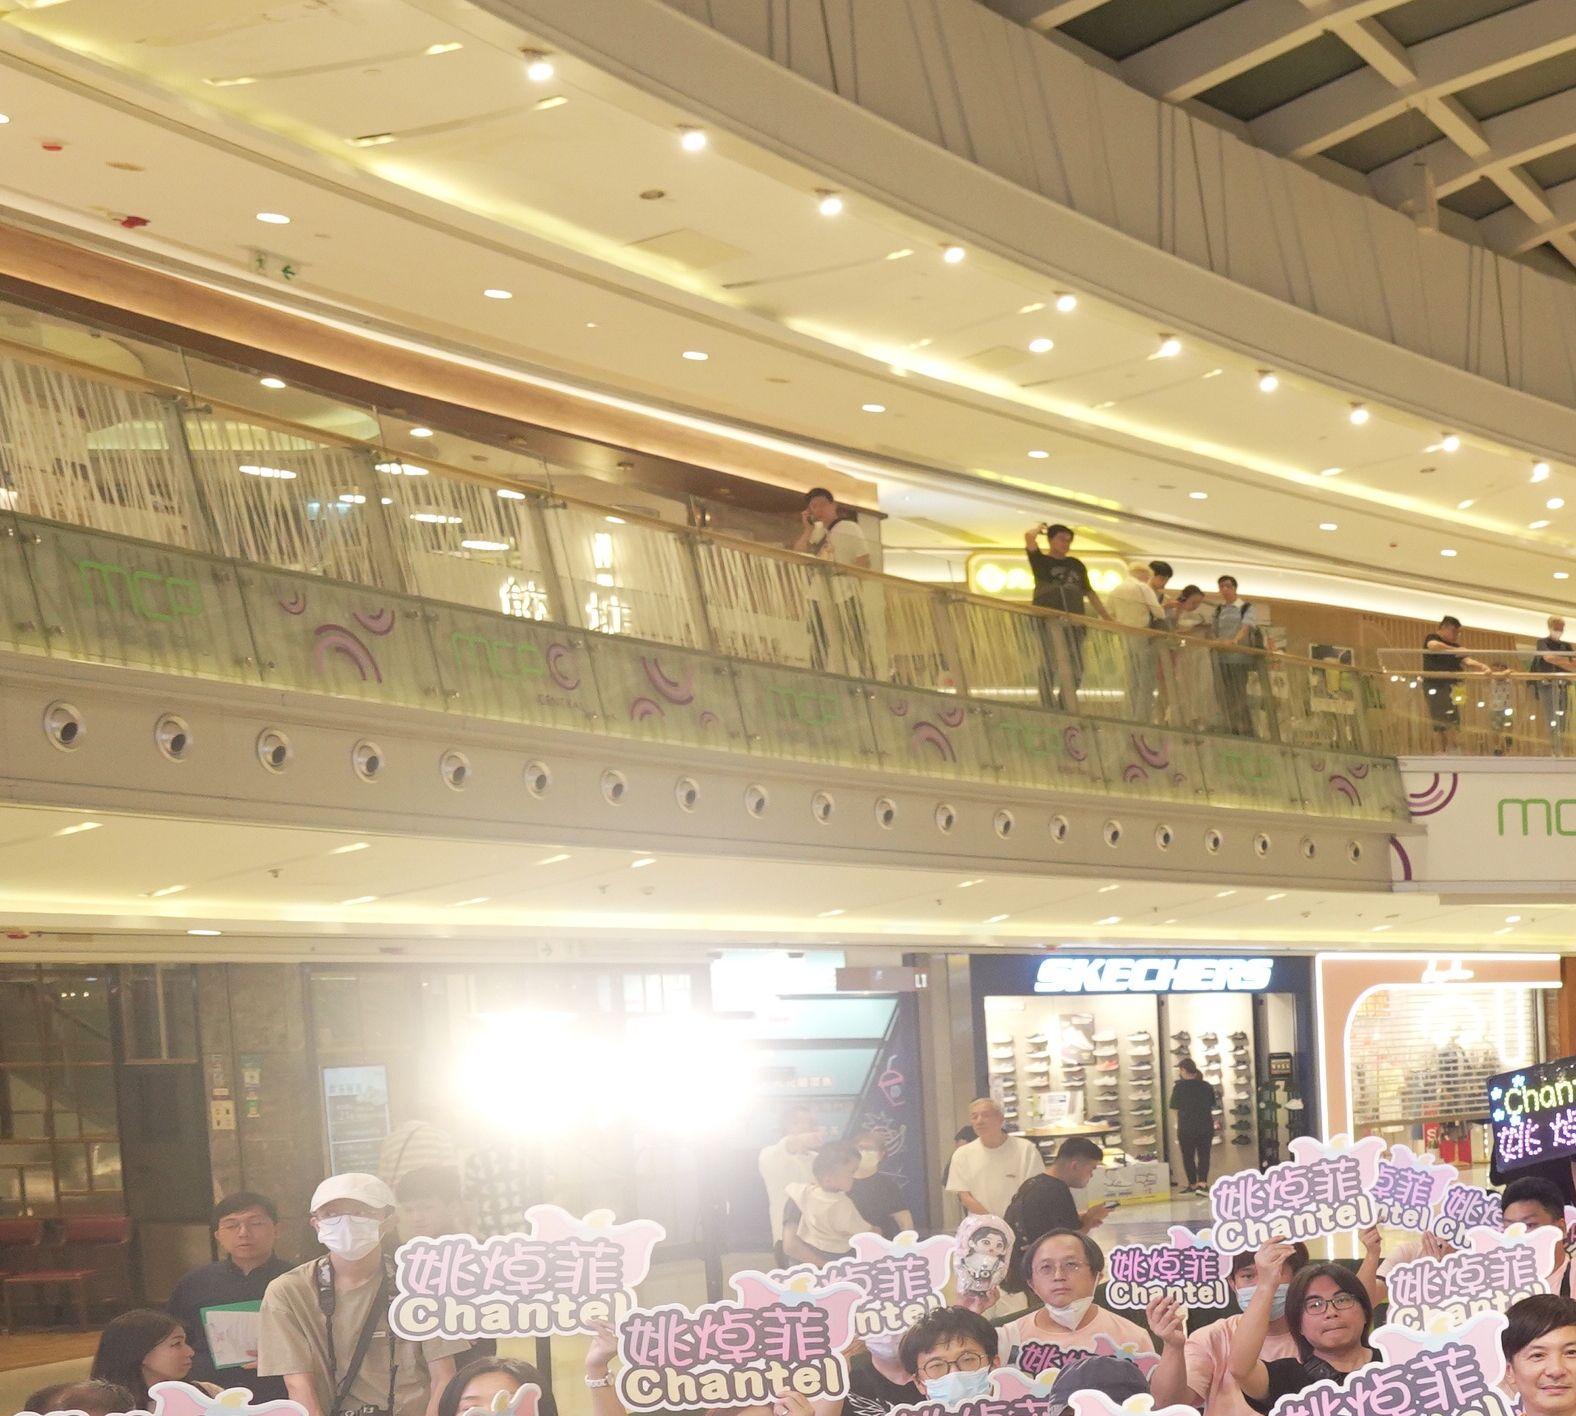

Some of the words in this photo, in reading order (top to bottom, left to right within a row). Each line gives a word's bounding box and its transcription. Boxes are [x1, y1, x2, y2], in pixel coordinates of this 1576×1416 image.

[1034, 956, 1274, 992] SKECHERS
[1219, 1162, 1360, 1219] 姚焯菲
[1217, 1198, 1371, 1249] Chantel
[407, 1241, 623, 1296] 姚焯菲
[1113, 1249, 1219, 1282] 姚焯菲
[1394, 1248, 1535, 1306] 姚焯菲
[400, 1294, 627, 1334] Chantel
[1112, 1281, 1223, 1306] Chantel
[626, 1308, 827, 1367] 姚焯菲
[625, 1359, 839, 1406] Chantel
